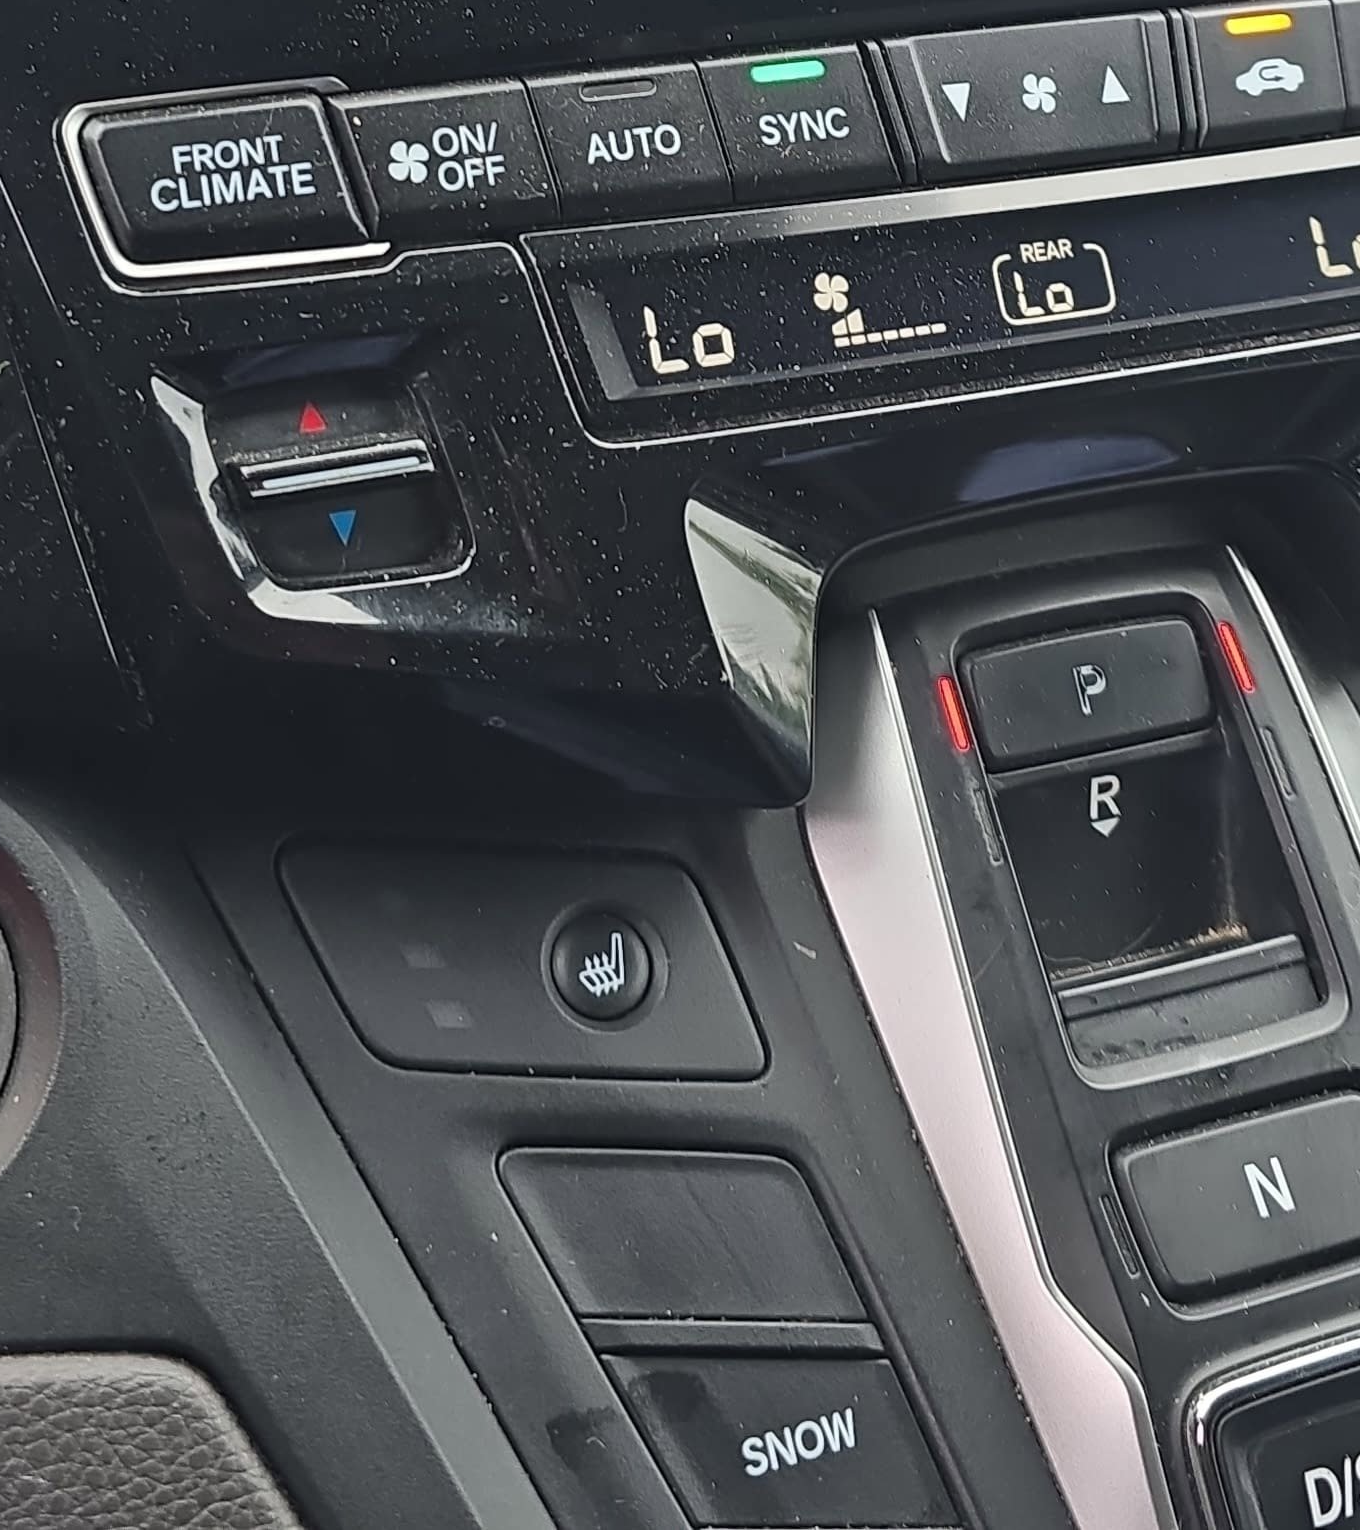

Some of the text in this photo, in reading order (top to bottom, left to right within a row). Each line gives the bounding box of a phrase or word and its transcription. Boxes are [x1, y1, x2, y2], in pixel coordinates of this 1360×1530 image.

[433, 121, 501, 157] ON/
[588, 125, 681, 164] AUTO
[759, 108, 849, 145] SYNC
[172, 134, 284, 173] FRONT
[438, 154, 505, 191] OFF
[151, 163, 316, 211] CLIMATE
[1020, 239, 1073, 263] REAR
[1017, 272, 1075, 316] Lo
[644, 307, 734, 374] Lo
[1073, 665, 1106, 715] P
[1090, 775, 1121, 820] R
[1245, 1157, 1295, 1218] N
[742, 1408, 854, 1476] SNOW
